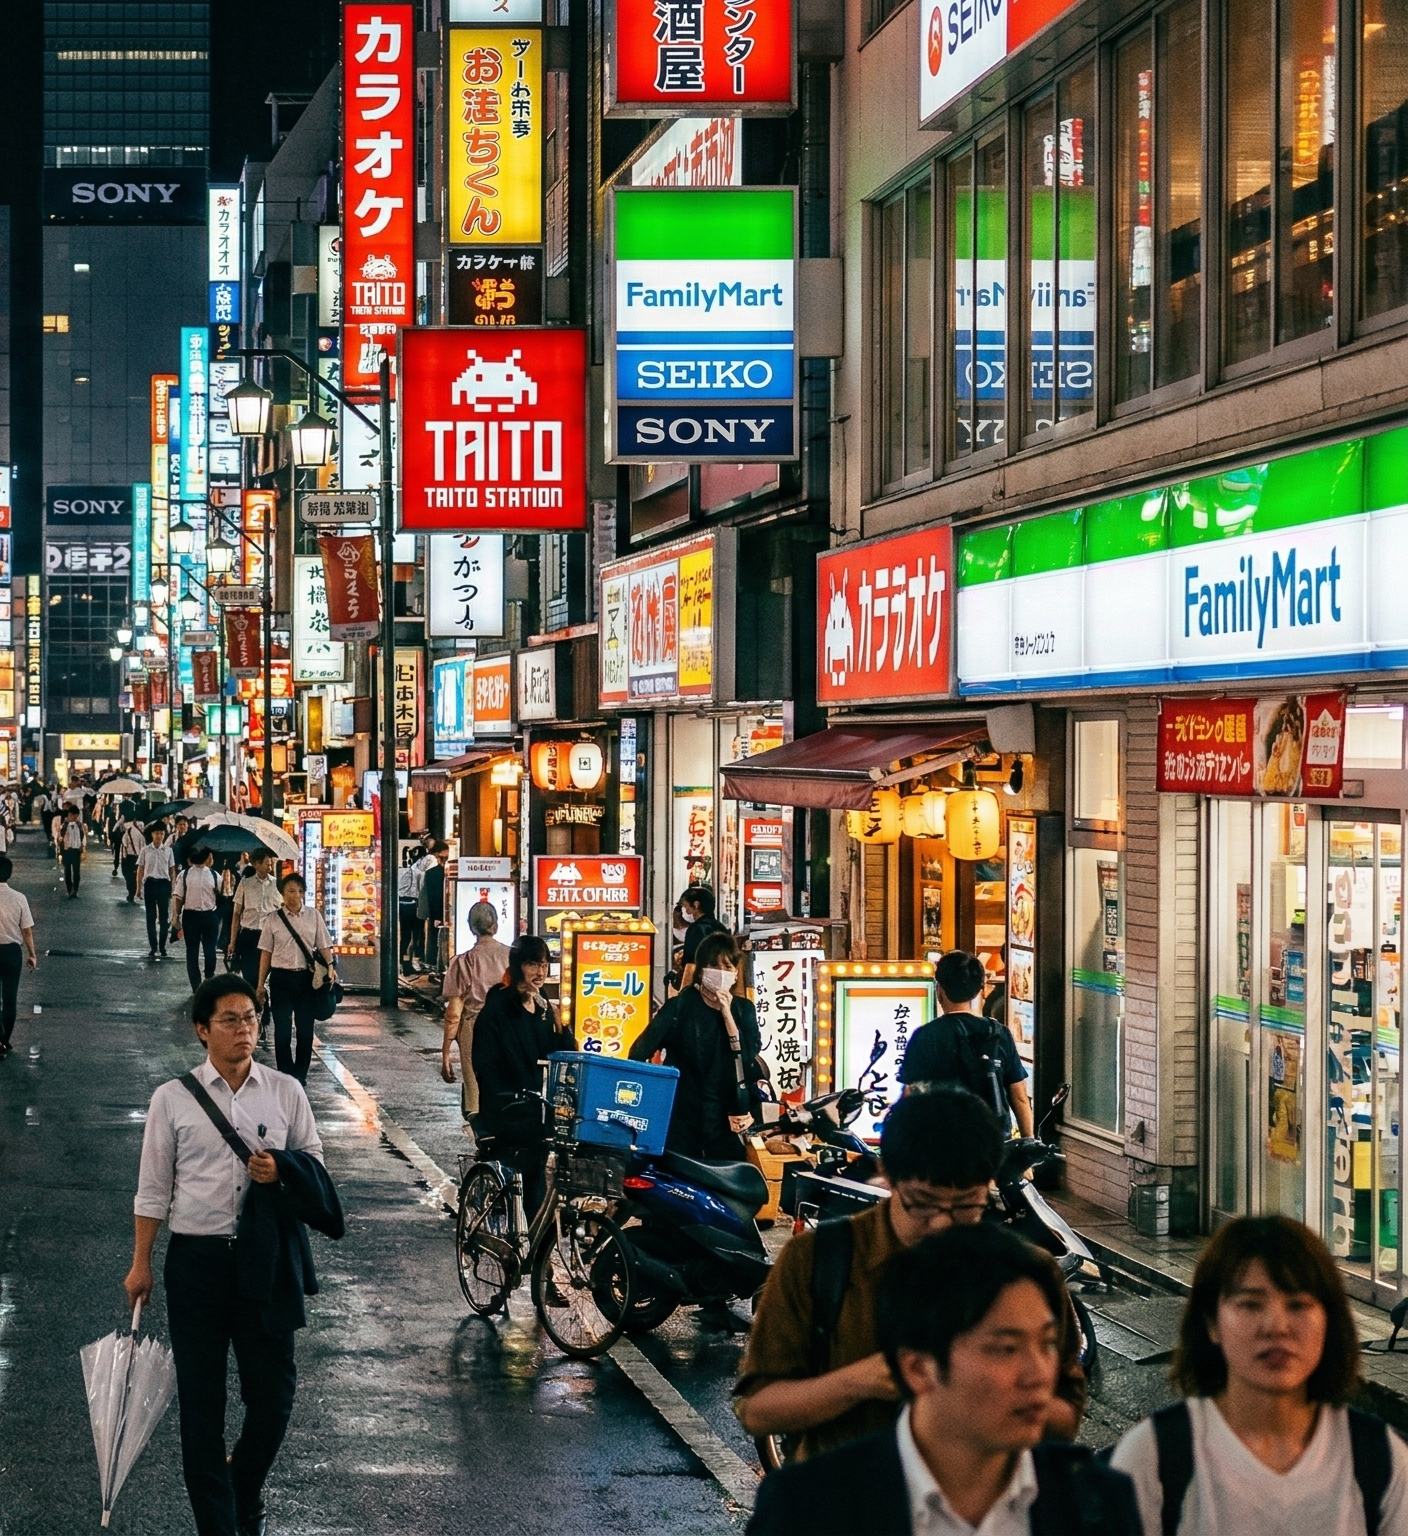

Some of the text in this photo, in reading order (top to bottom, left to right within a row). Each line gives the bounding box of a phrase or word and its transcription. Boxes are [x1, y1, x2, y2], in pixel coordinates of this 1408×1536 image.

[725, 0, 756, 94] ンター
[354, 16, 404, 238] カラオケ
[72, 183, 180, 204] SONY
[352, 282, 405, 306] TAITO
[627, 281, 782, 312] FamilyMart
[637, 360, 773, 389] SEIKO
[636, 418, 774, 443] SONY
[425, 421, 562, 482] TAITO
[53, 500, 124, 515] SONY
[424, 487, 562, 508] TAITO STATION
[1184, 545, 1341, 649] FamilyMart
